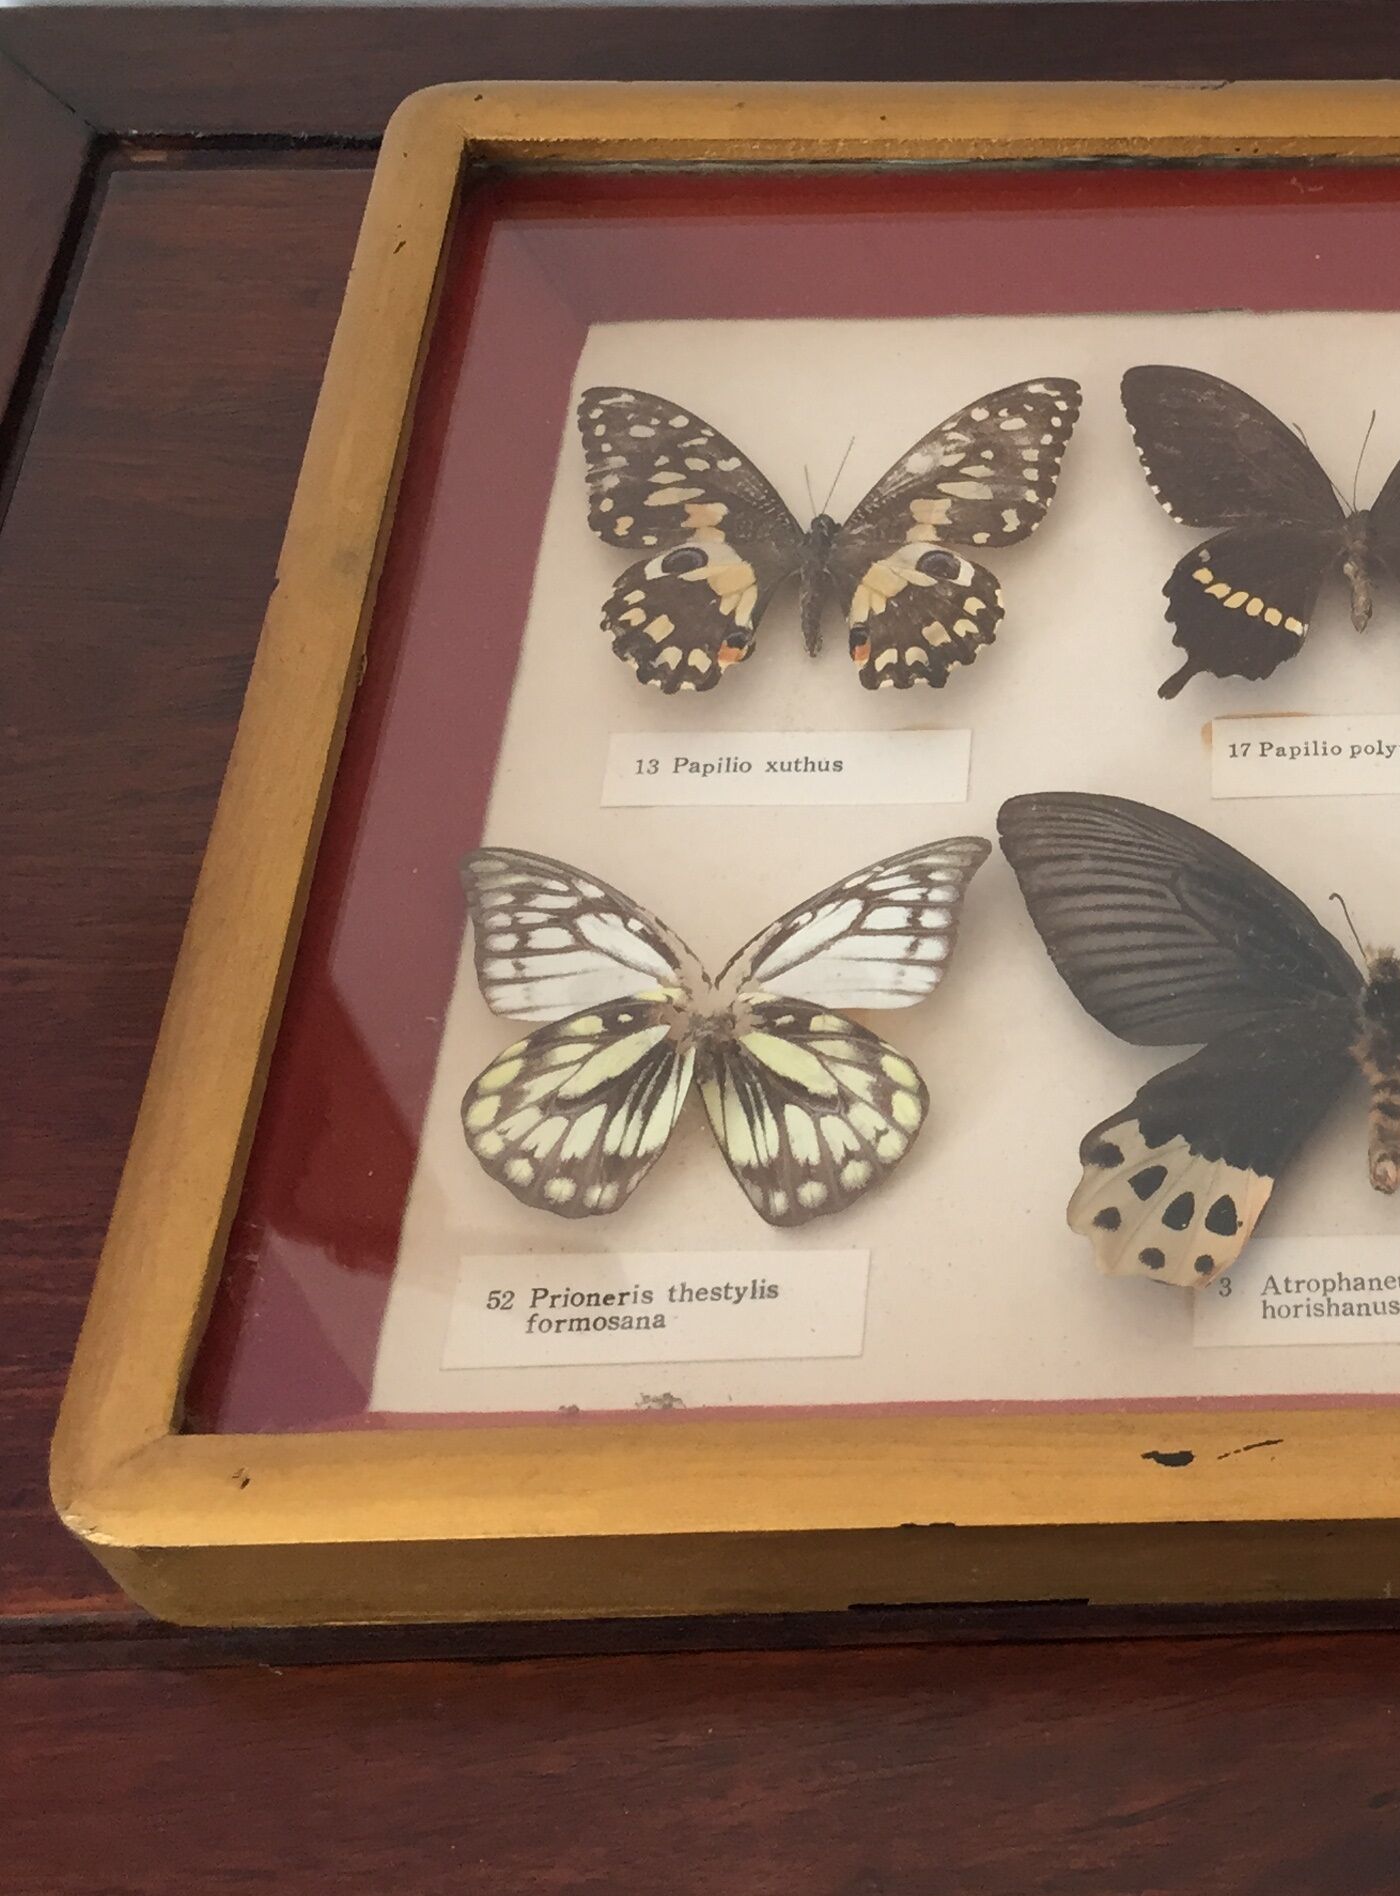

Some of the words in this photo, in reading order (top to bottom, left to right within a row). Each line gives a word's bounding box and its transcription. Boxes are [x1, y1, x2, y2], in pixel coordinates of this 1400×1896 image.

[1228, 742, 1252, 759] 17
[1258, 741, 1343, 760] Papilio
[634, 758, 662, 776] 13
[671, 756, 753, 778] Papilio
[764, 755, 845, 774] xuthus
[486, 1289, 516, 1311] 52
[529, 1283, 655, 1309] Prioneris
[667, 1279, 780, 1305] thestylis
[1261, 1297, 1400, 1320] horishanus
[524, 1312, 667, 1335] formosana
